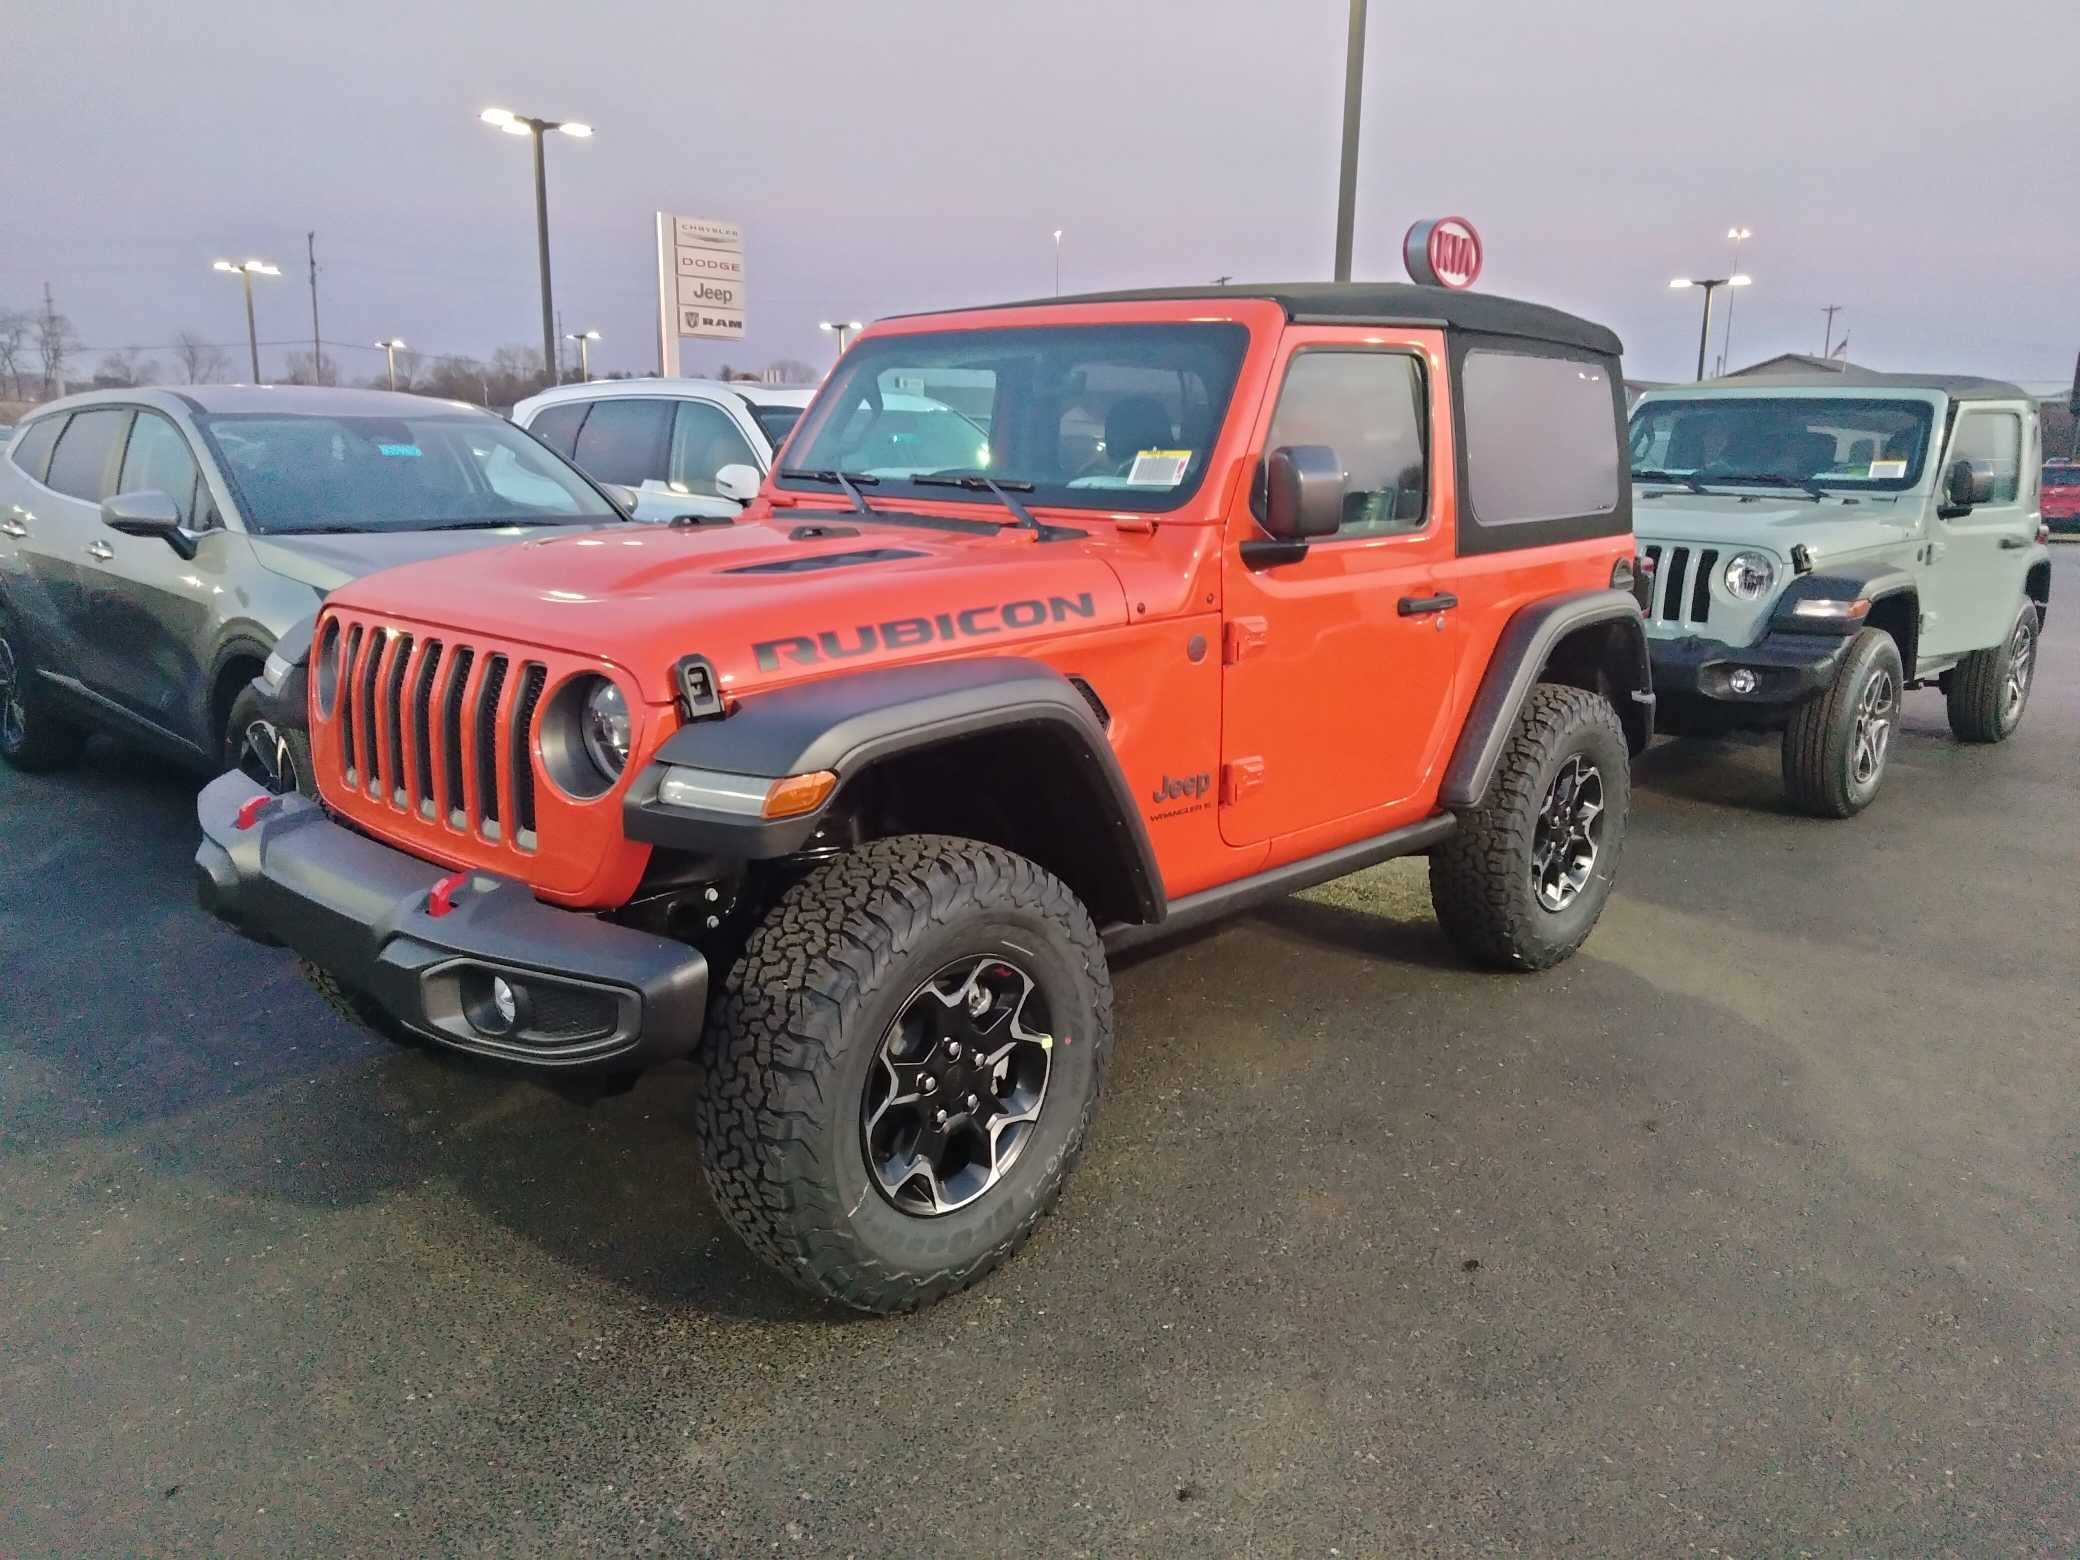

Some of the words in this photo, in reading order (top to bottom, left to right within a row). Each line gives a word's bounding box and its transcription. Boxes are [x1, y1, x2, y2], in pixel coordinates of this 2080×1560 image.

[681, 223, 739, 236] CHRYSLER
[681, 257, 741, 272] DODGE
[693, 282, 733, 304] Jeep
[702, 317, 742, 329] RAM
[751, 592, 1096, 673] RUBICON
[1152, 772, 1210, 804] Jeep
